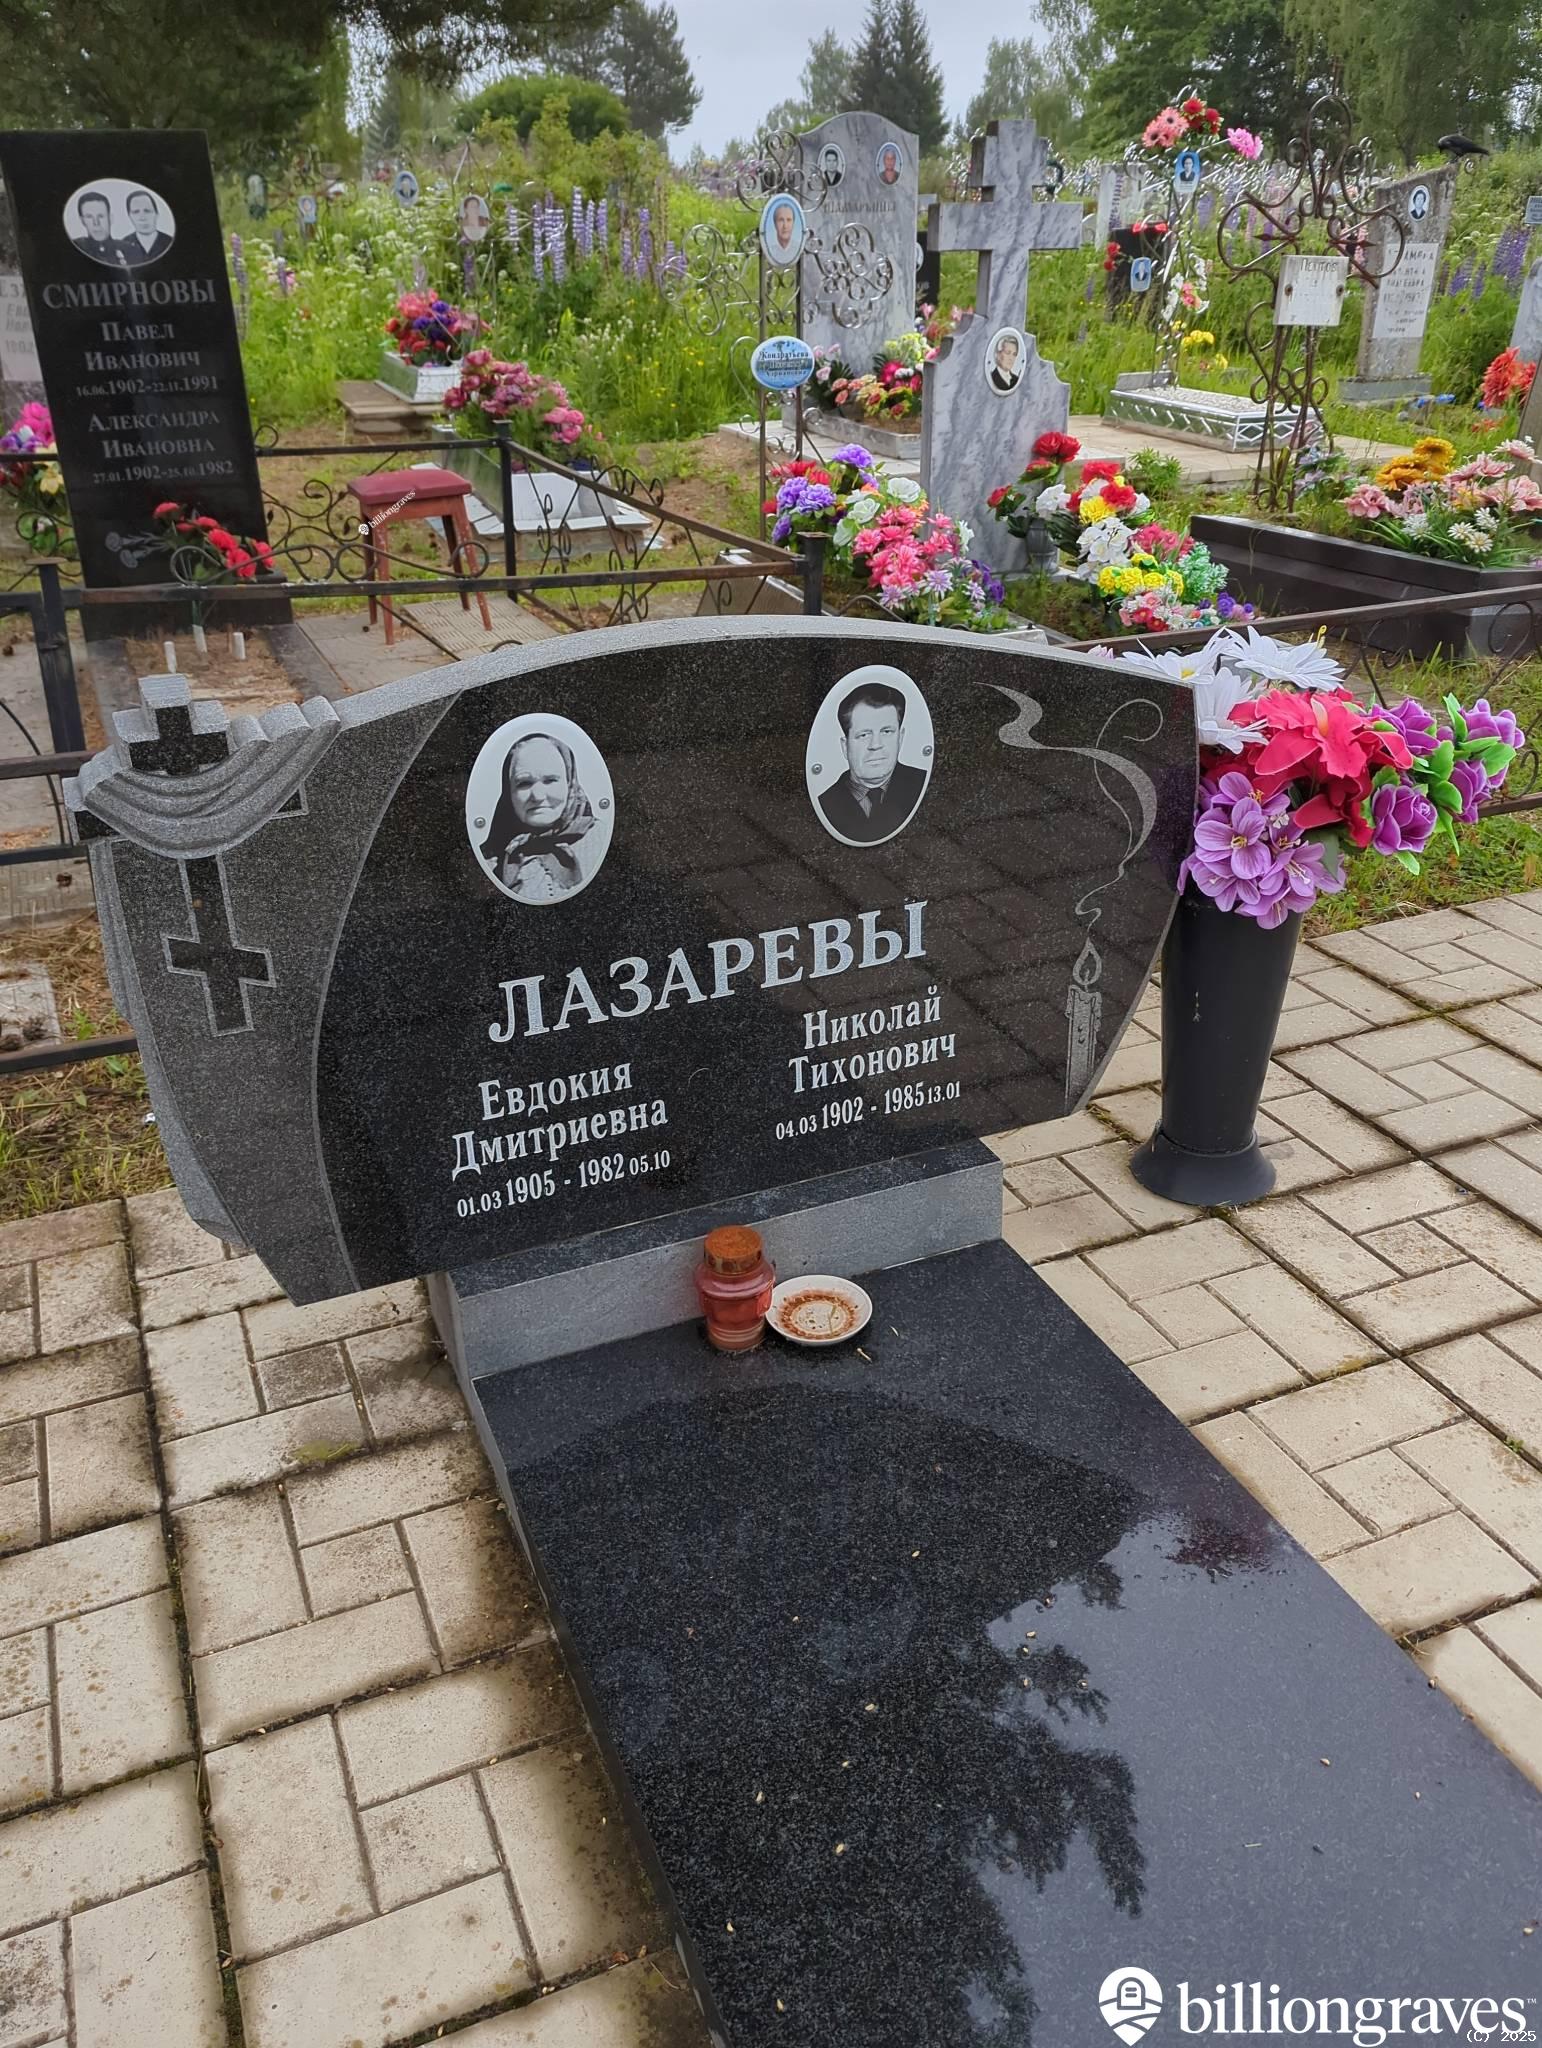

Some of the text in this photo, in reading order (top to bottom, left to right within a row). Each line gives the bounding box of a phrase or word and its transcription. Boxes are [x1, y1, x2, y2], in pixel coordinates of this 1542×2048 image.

[43, 279, 216, 309] СМИРНОВЫ
[489, 900, 928, 1042] ЛАЗАРЕВЫ
[803, 984, 942, 1049] Николай
[478, 1063, 633, 1120] Евдокия
[788, 1033, 956, 1093] Тихонович
[452, 1099, 668, 1182] Дмитриевна
[775, 1115, 817, 1140] 04.03
[822, 1096, 863, 1130] 1902
[884, 1081, 924, 1114] 1985
[927, 1081, 961, 1104] 13.01
[457, 1190, 502, 1217] 01.03
[506, 1169, 555, 1206] 1905
[578, 1152, 625, 1187] 1982
[629, 1150, 671, 1175] 05.10
